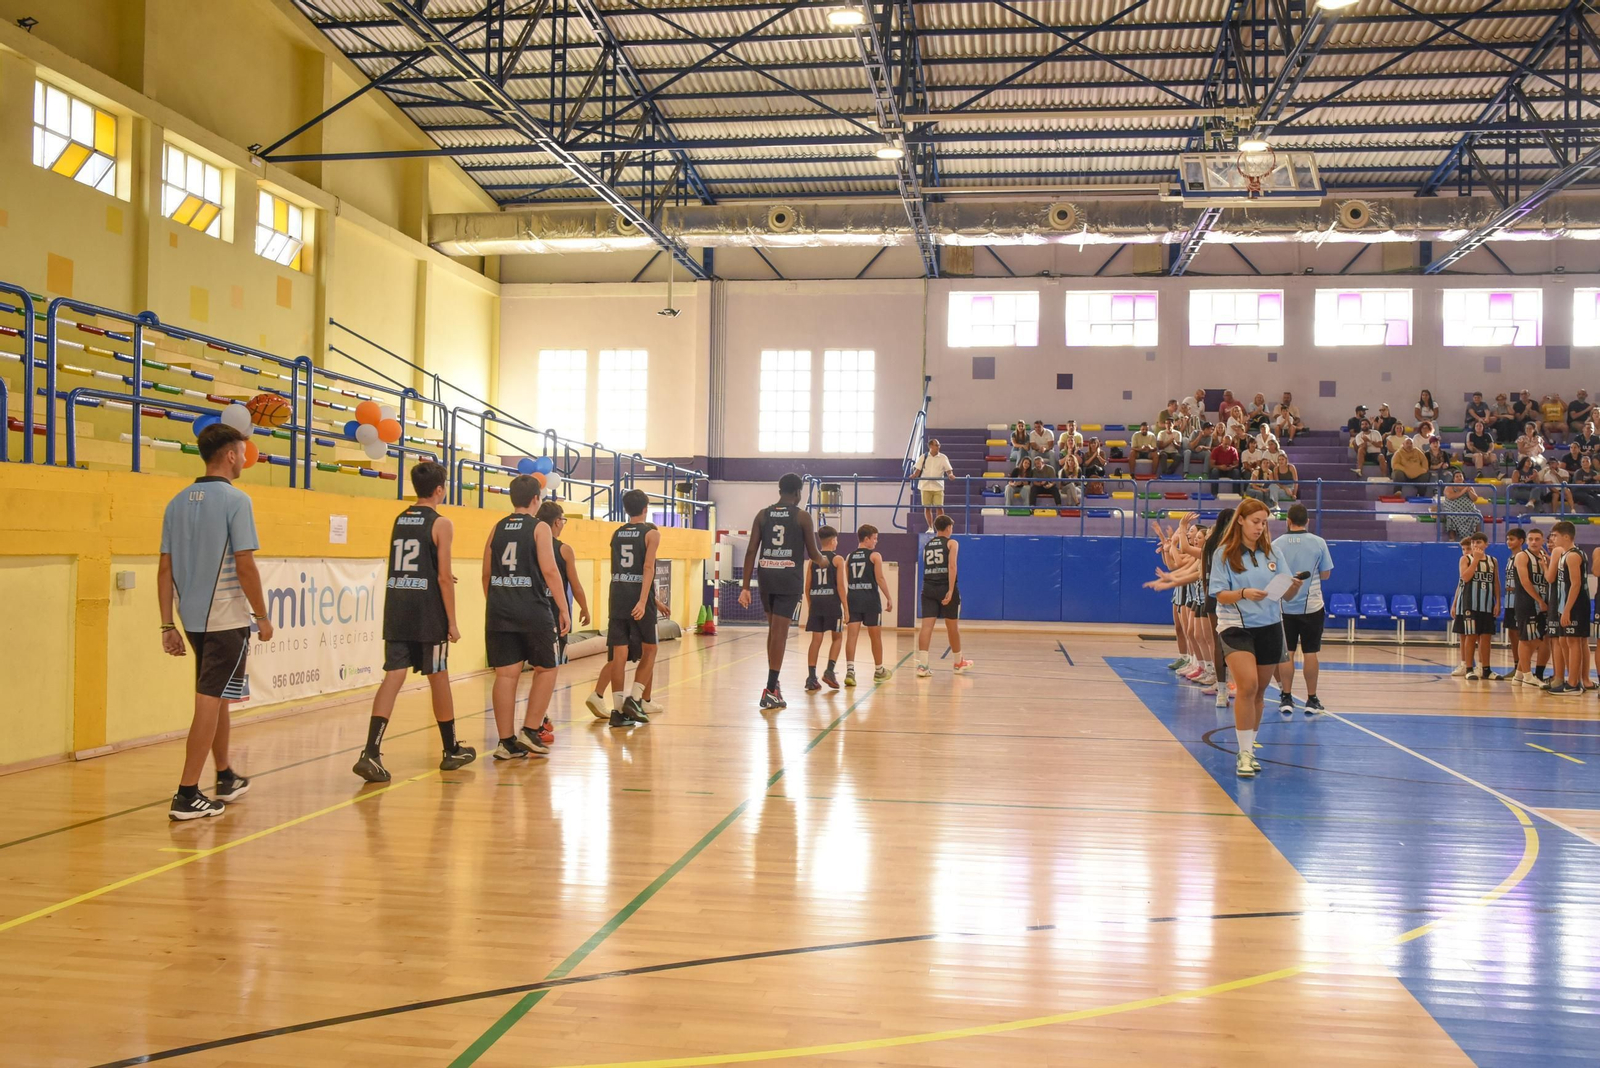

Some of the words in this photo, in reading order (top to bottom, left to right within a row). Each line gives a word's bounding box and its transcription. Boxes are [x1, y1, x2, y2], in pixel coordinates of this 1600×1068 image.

[771, 524, 785, 546] 3
[393, 538, 420, 572] 12
[501, 541, 518, 571] 4
[620, 544, 634, 568] 5
[926, 548, 944, 565] 25
[815, 568, 828, 586] 11
[850, 561, 866, 579] 17
[386, 576, 396, 588] A
[1481, 582, 1486, 590] 6
[319, 630, 375, 650] Algeciras
[272, 675, 288, 689] 956
[289, 671, 305, 686] 020
[305, 668, 320, 682] 666
